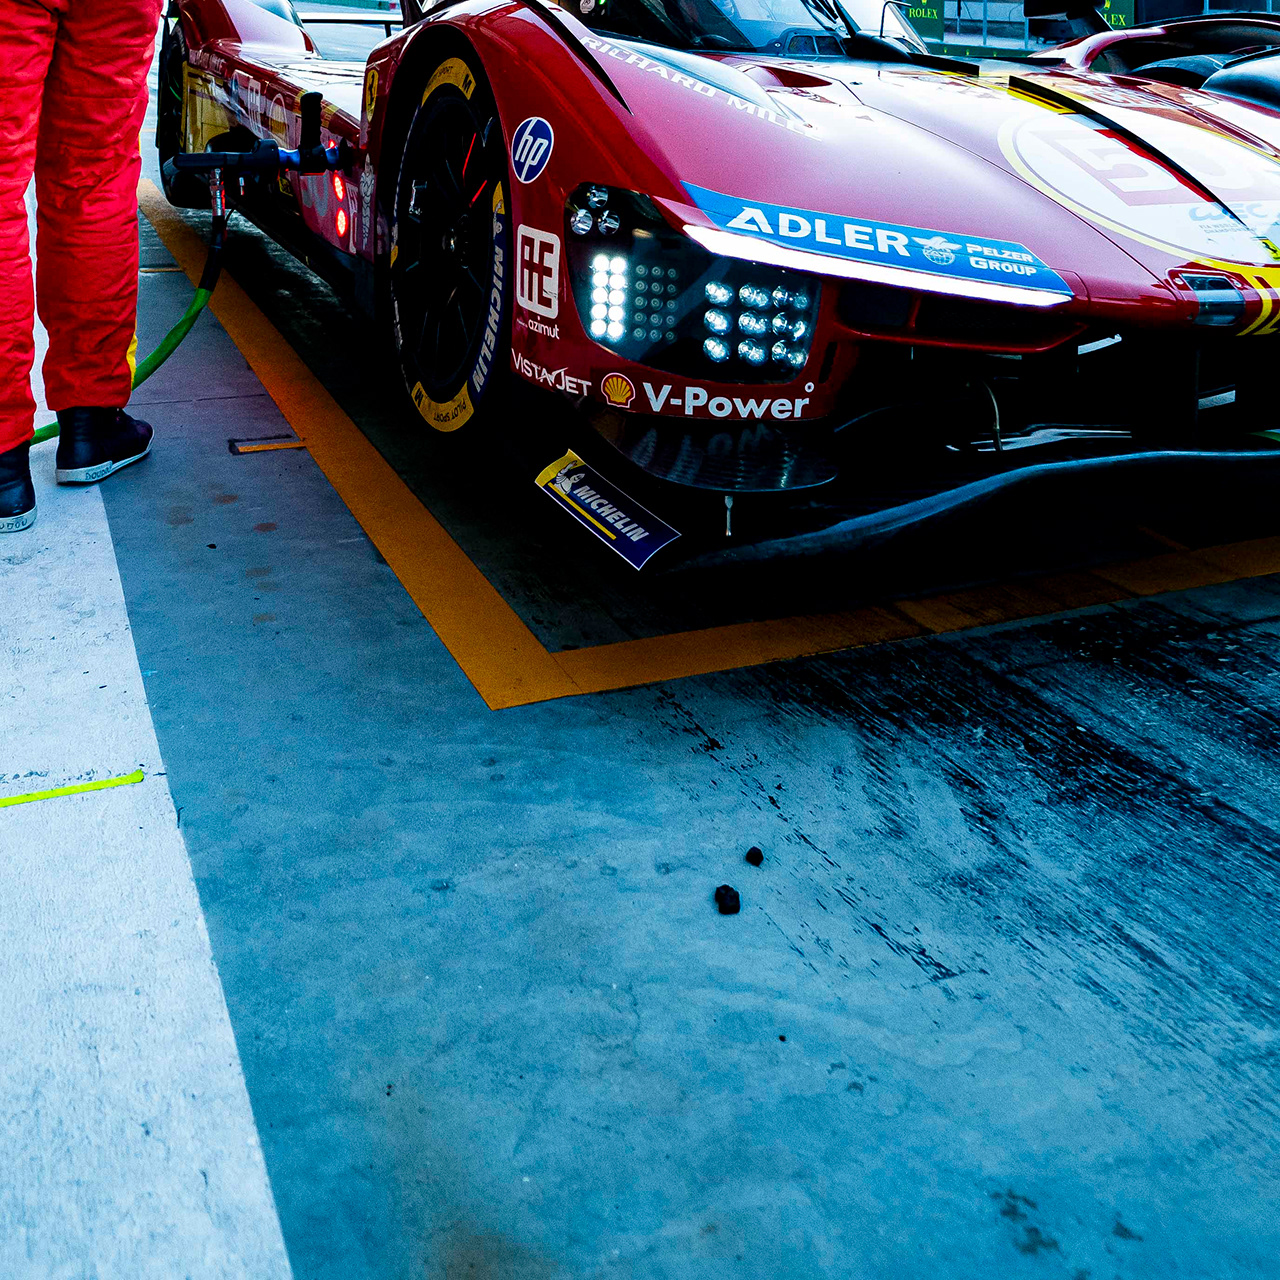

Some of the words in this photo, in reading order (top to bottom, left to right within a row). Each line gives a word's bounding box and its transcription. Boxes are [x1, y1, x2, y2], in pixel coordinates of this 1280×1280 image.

[908, 7, 938, 20] ROLEX
[579, 35, 718, 98] RICHARD
[514, 119, 549, 182] hp
[725, 206, 911, 257] ADLER
[965, 242, 1034, 263] PELZER
[969, 255, 1038, 277] GROUP
[471, 247, 504, 394] MICHELIN
[528, 315, 560, 340] azimut
[642, 382, 810, 419] V-Power
[573, 484, 650, 542] MICHELIN
